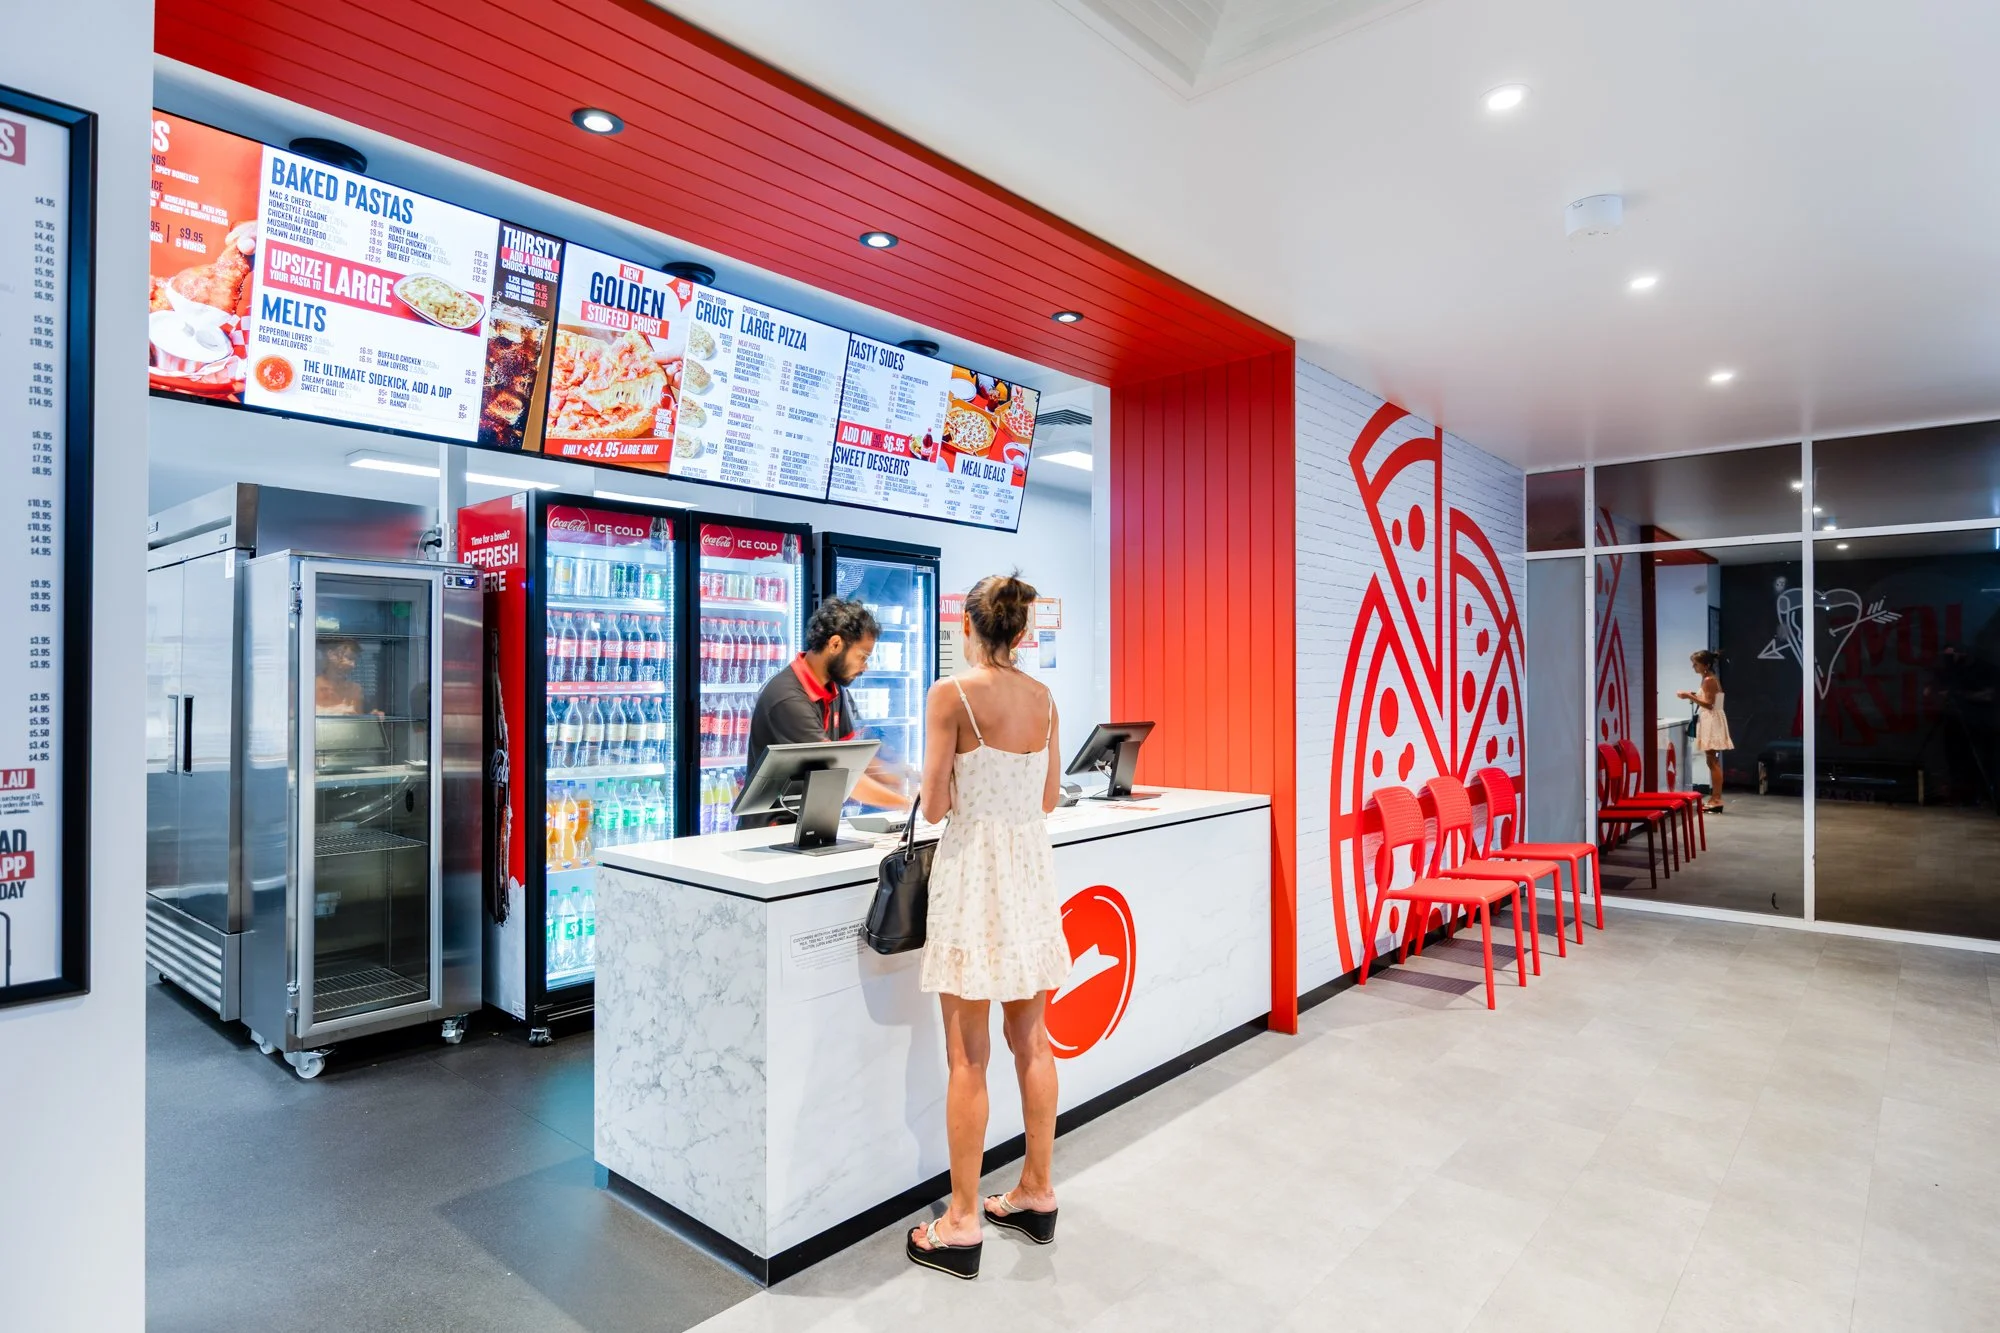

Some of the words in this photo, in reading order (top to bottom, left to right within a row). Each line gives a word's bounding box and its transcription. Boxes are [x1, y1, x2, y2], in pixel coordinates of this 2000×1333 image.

[272, 156, 338, 202] BAKED
[345, 178, 414, 224] PASTAS
[269, 189, 282, 201] MAC
[291, 195, 312, 209] CHEESE
[268, 199, 301, 215] HOMESTYLE
[303, 207, 328, 222] LASAGNE
[268, 209, 292, 224] CHICKEN
[294, 215, 319, 228] ALFREDO
[370, 220, 384, 228] $9.95
[180, 228, 203, 243] $9.95
[266, 227, 288, 239] PRAWN
[290, 232, 314, 246] ALFREDO
[267, 218, 301, 234] MUSHROOM
[303, 226, 326, 240] ALFREDO
[370, 228, 384, 238] $9.95
[388, 224, 406, 237] HONEY
[407, 229, 419, 239] HAM
[183, 240, 206, 254] WINGS
[369, 237, 383, 246] $9.95
[388, 233, 404, 245] ROAST
[406, 238, 427, 250] CHICKEN
[502, 226, 561, 261] THIRSTY
[368, 246, 382, 255] $9.95
[386, 250, 397, 260] BBQ
[399, 253, 410, 263] BEEF
[387, 242, 409, 255] BUFFALO
[410, 247, 432, 260] CHICKEN
[474, 250, 489, 259] $12.95
[365, 254, 381, 263] $12.95
[473, 259, 488, 268] $12.95
[510, 251, 524, 263] ADD
[525, 255, 530, 265] A
[532, 256, 552, 270] DRINK
[270, 248, 322, 280] UPSIZE
[323, 262, 395, 308] LARGE
[502, 259, 526, 275] CHOOSE
[528, 265, 543, 279] YOUR
[545, 270, 558, 282] SIZE
[623, 266, 640, 281] NEW
[269, 269, 288, 283] YOUR
[290, 274, 311, 288] PASTA
[313, 281, 321, 291] TO
[589, 271, 665, 320] GOLDEN
[698, 291, 714, 303] CHOOSE
[716, 296, 727, 306] YOUR
[261, 294, 326, 332] MELTS
[696, 300, 734, 329] CRUST
[743, 305, 758, 316] CHOOSE
[759, 310, 769, 320] YOUR
[587, 305, 629, 330] STUFFED
[631, 315, 662, 337] CRUST
[259, 325, 290, 340] PEPPERONI
[292, 332, 312, 343] LOVERS
[740, 313, 776, 342] LARGE
[778, 325, 807, 351] PIZZA
[258, 335, 270, 344] BBQ
[271, 337, 307, 351] MEATLOVERS
[377, 350, 399, 363] BUFFALO
[400, 354, 421, 366] CHICKEN
[850, 340, 878, 363] TASTY
[879, 348, 905, 371] SIDES
[377, 358, 388, 368] HAM
[389, 360, 409, 372] LOVERS
[301, 375, 324, 386] CREAMY
[326, 378, 345, 390] GARLIC
[303, 359, 320, 374] THE
[323, 362, 366, 384] ULTIMATE
[369, 373, 410, 392] SIDEKICK,
[412, 382, 429, 396] ADD
[431, 385, 437, 396] A
[438, 387, 452, 399] DIP
[301, 382, 319, 394] SWEET
[320, 386, 337, 396] CHILLI
[390, 391, 410, 401] TOMATO
[390, 399, 407, 409] RANCH
[842, 426, 860, 443] ADD
[860, 430, 873, 446] ON
[883, 434, 905, 452] $6.95
[33, 443, 52, 452] $7.95
[563, 444, 582, 455] ONLY
[620, 444, 640, 455] LARGE
[642, 445, 658, 455] ONLY
[32, 455, 52, 464] $7.95
[834, 446, 866, 468] SWEET
[867, 453, 910, 476] DESSERTS
[961, 459, 981, 478] MEAL
[983, 464, 1006, 482] DEALS
[549, 517, 588, 532] Coca-Cola
[594, 524, 612, 534] ICE
[614, 526, 644, 537] COLD
[31, 535, 51, 544] $4.95
[471, 536, 482, 546] Time
[494, 530, 510, 541] break?
[701, 534, 733, 548] Coca-Cola
[738, 539, 752, 549] ICE
[753, 541, 777, 551] COLD
[31, 547, 51, 556] $4.95
[464, 542, 518, 568] REFRESH
[31, 580, 51, 588] $9.95
[483, 570, 506, 593] ERE
[30, 592, 50, 600] $9.95
[30, 604, 50, 612] $9.95
[30, 636, 50, 644] $3.95
[940, 630, 950, 640] ION
[30, 648, 50, 656] $3.95
[30, 660, 50, 668] $3.95
[30, 693, 50, 701] $3.95
[29, 705, 49, 713] $4.95
[29, 717, 49, 725] $5.95
[29, 741, 49, 749] $3.45
[29, 753, 49, 761] $4.95
[0, 770, 28, 788] .AU
